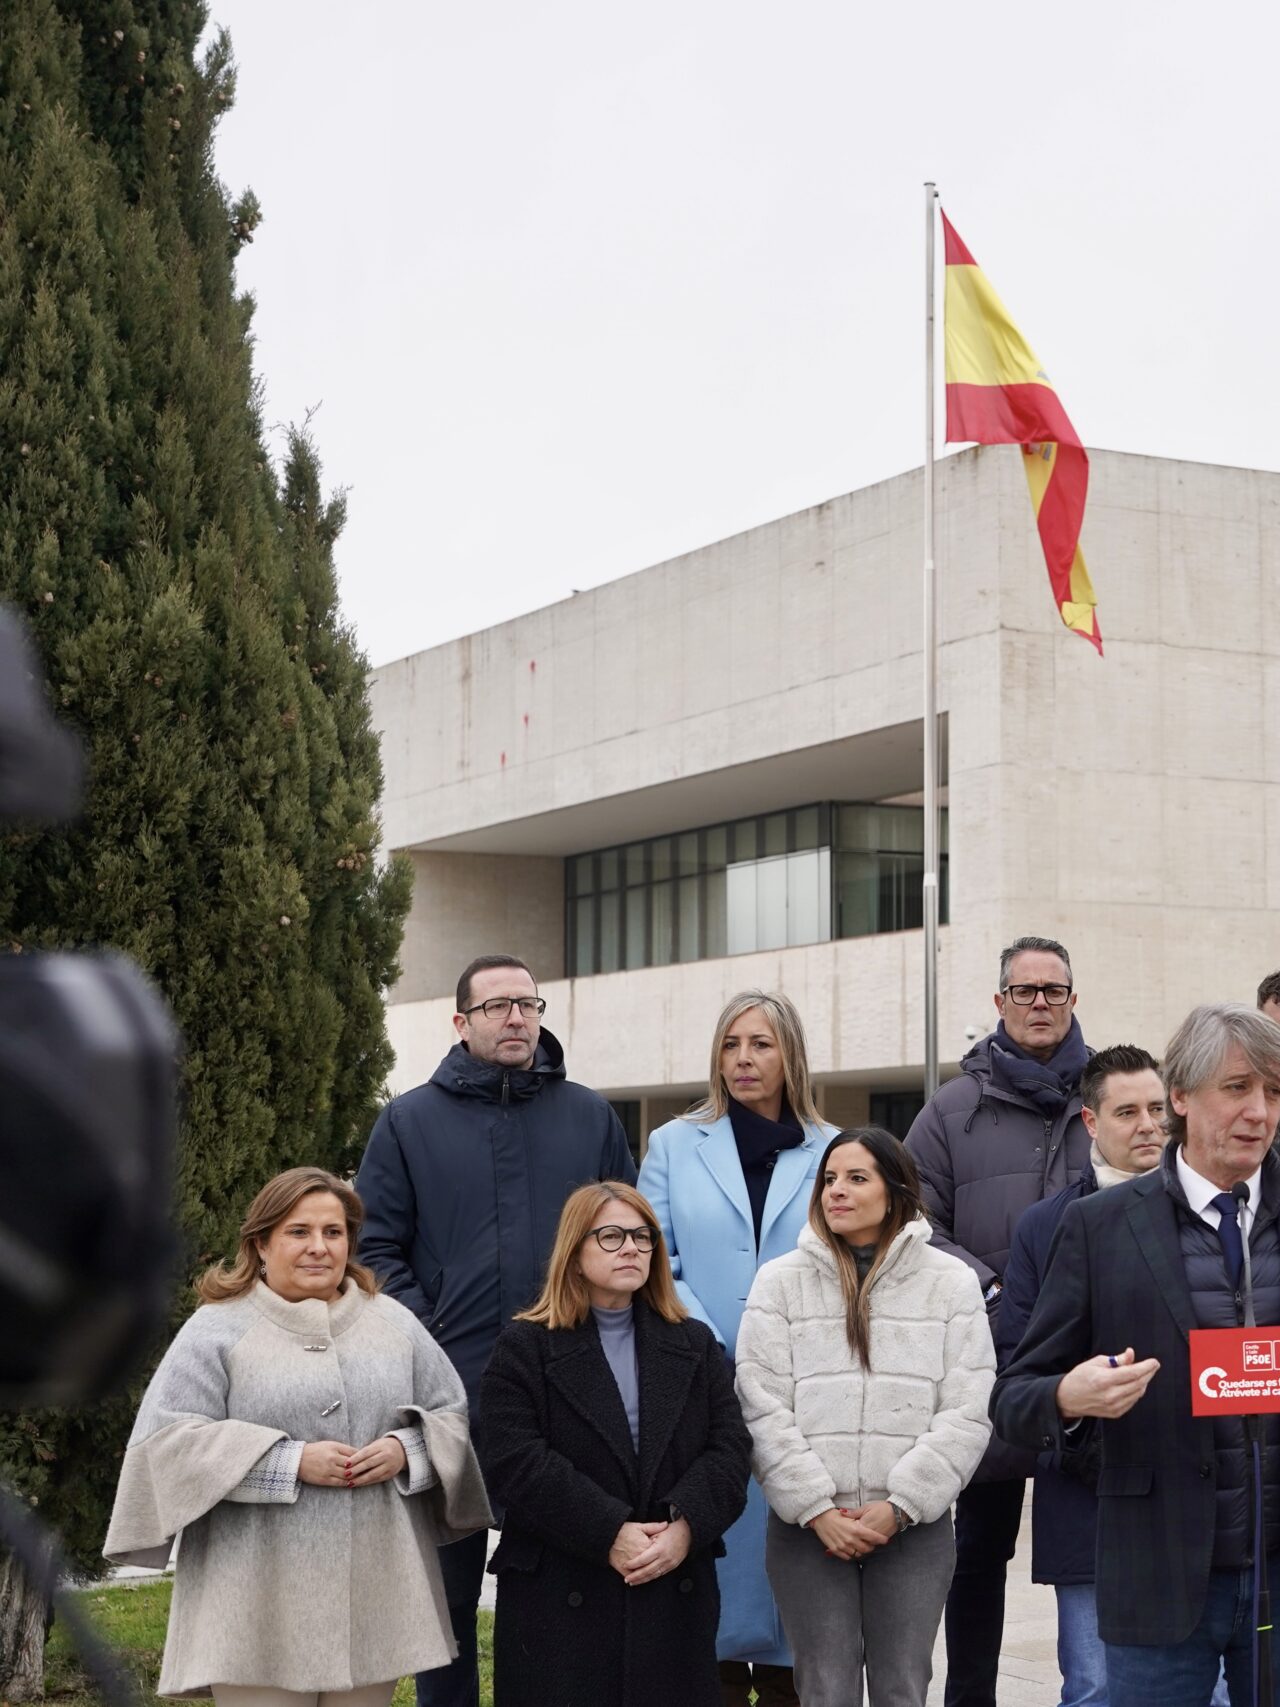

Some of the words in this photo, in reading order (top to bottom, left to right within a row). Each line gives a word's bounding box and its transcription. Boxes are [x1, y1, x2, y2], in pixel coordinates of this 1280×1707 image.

[1246, 1354, 1271, 1365] PSOE
[1218, 1379, 1265, 1389] Quedarse
[1219, 1387, 1261, 1398] Atrévete
[1262, 1386, 1271, 1396] al
